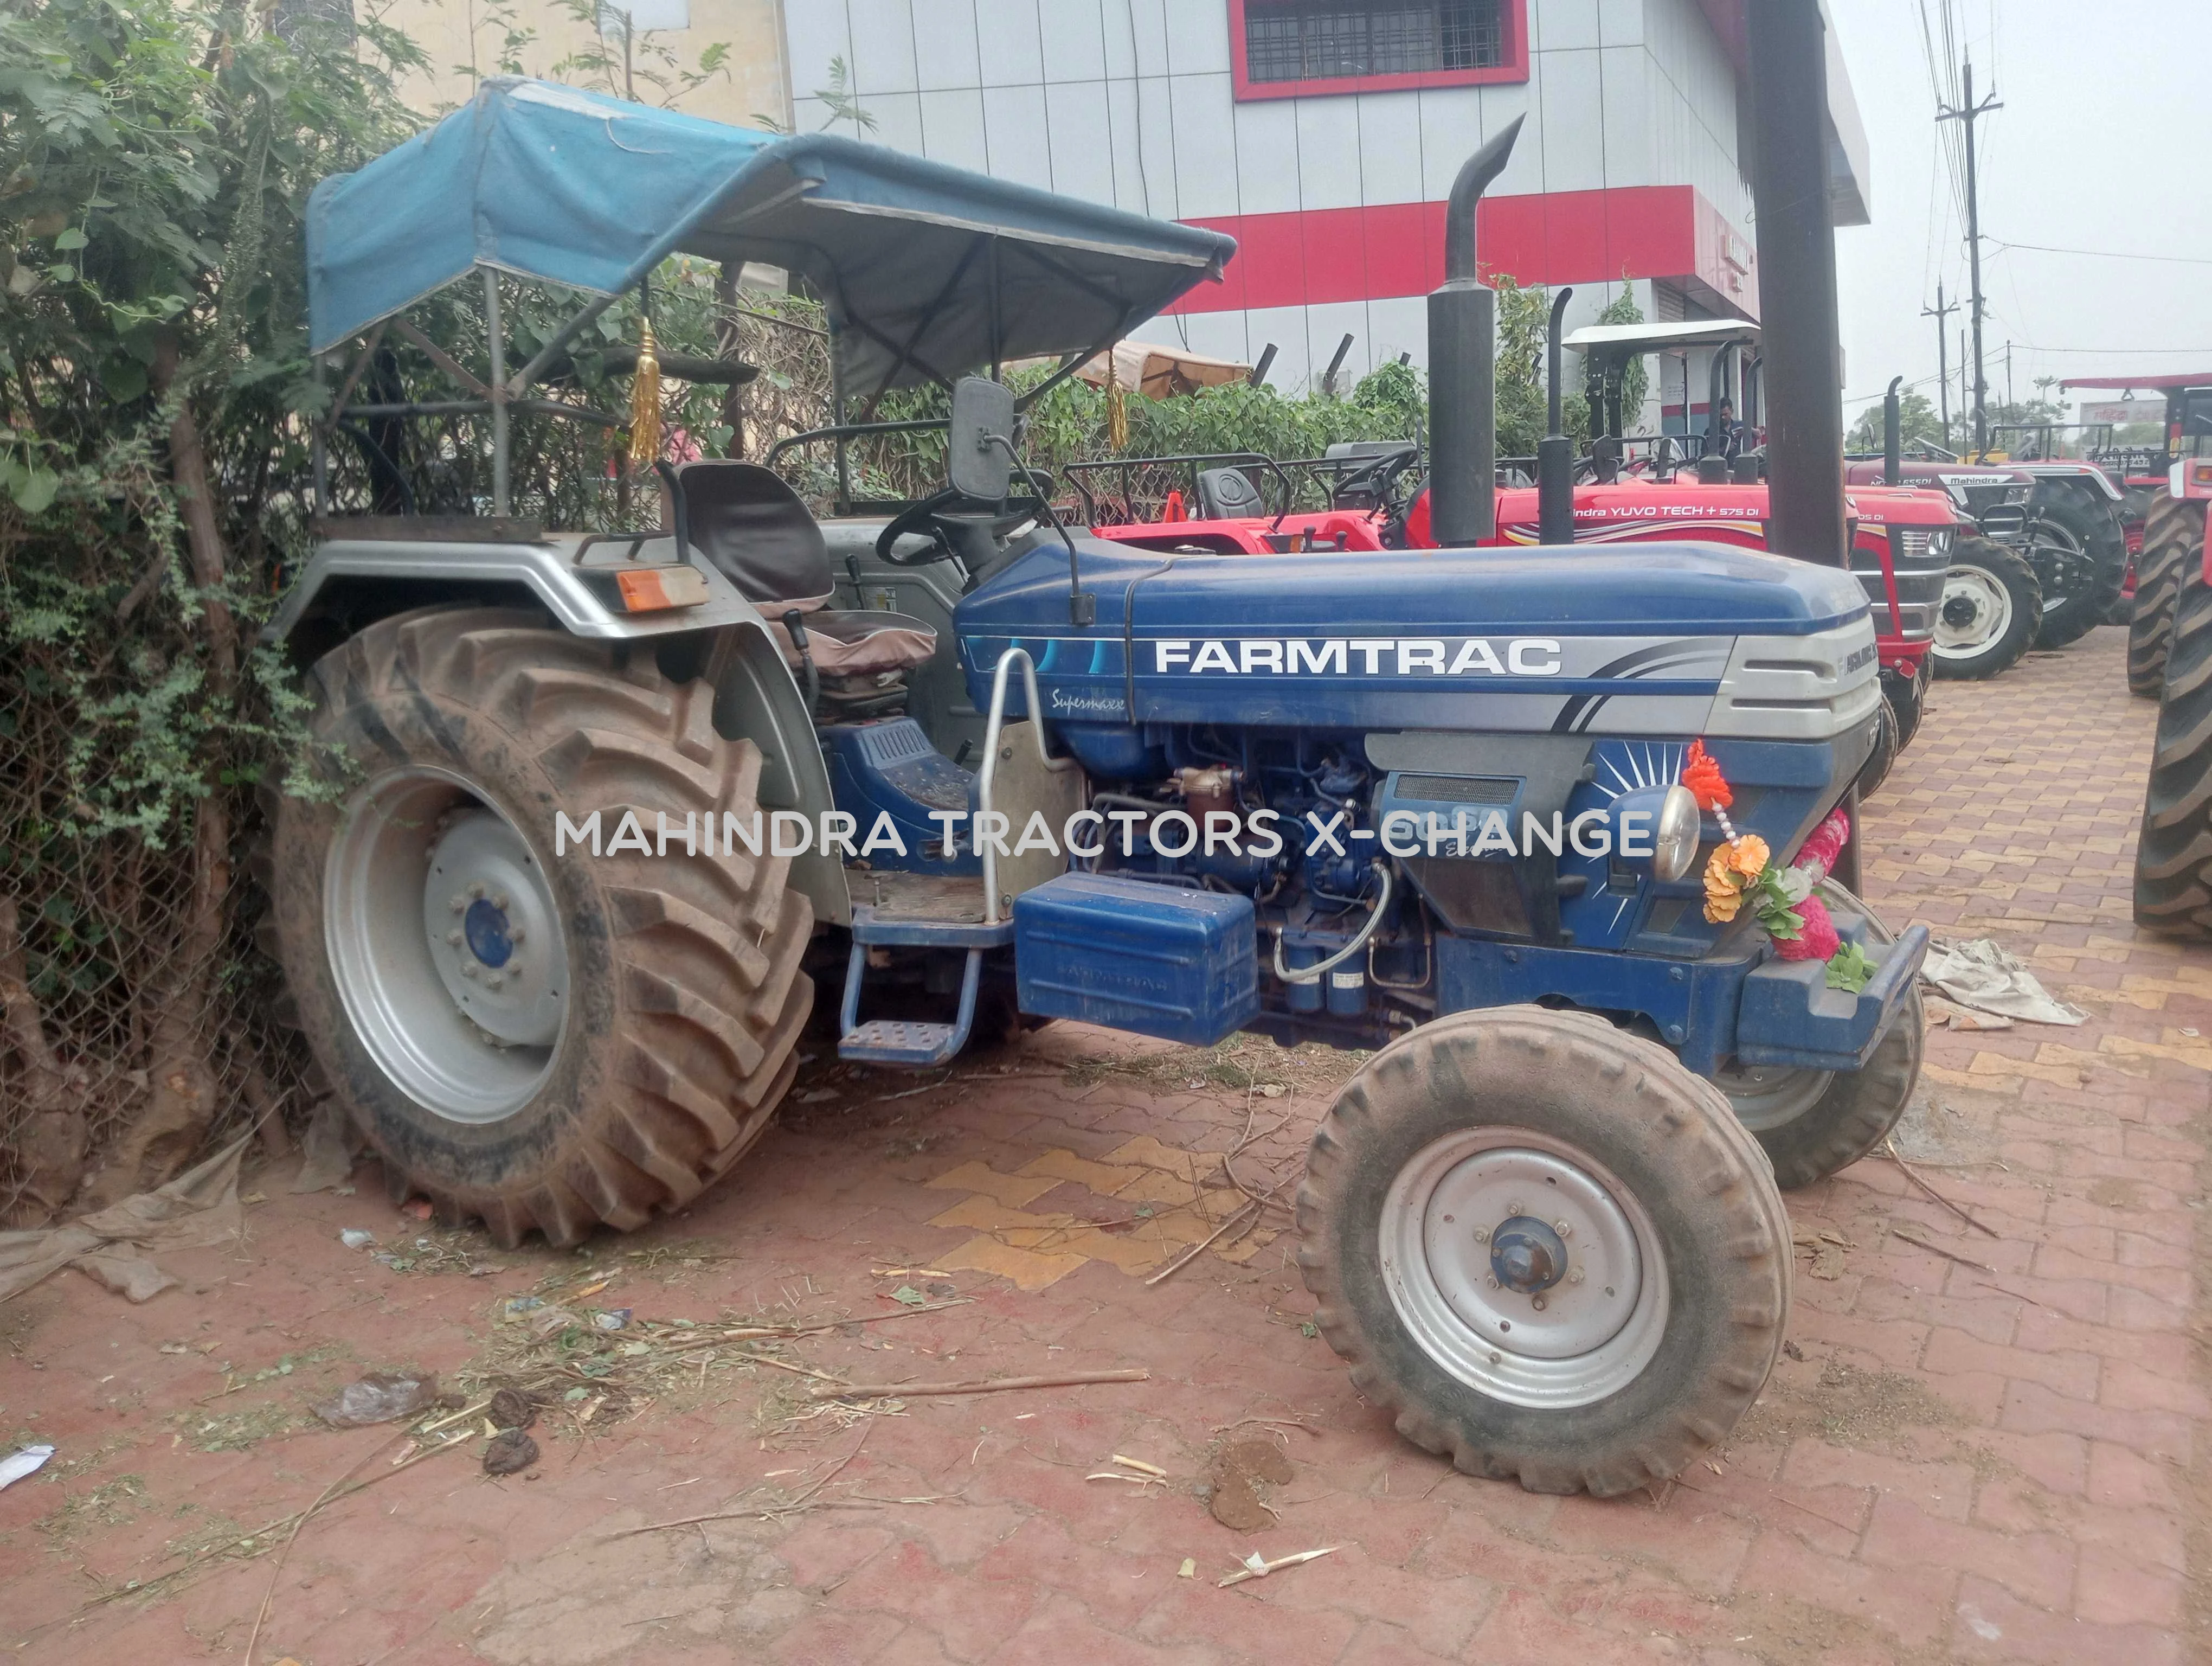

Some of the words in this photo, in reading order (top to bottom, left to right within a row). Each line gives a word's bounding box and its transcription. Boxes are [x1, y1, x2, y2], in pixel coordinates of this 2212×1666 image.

[1573, 508, 1606, 517] indra
[1611, 507, 1657, 516] YUVO
[1661, 506, 1703, 516] TECH
[1156, 639, 1562, 676] FARMTRAC
[1052, 688, 1126, 717] Supermaxx
